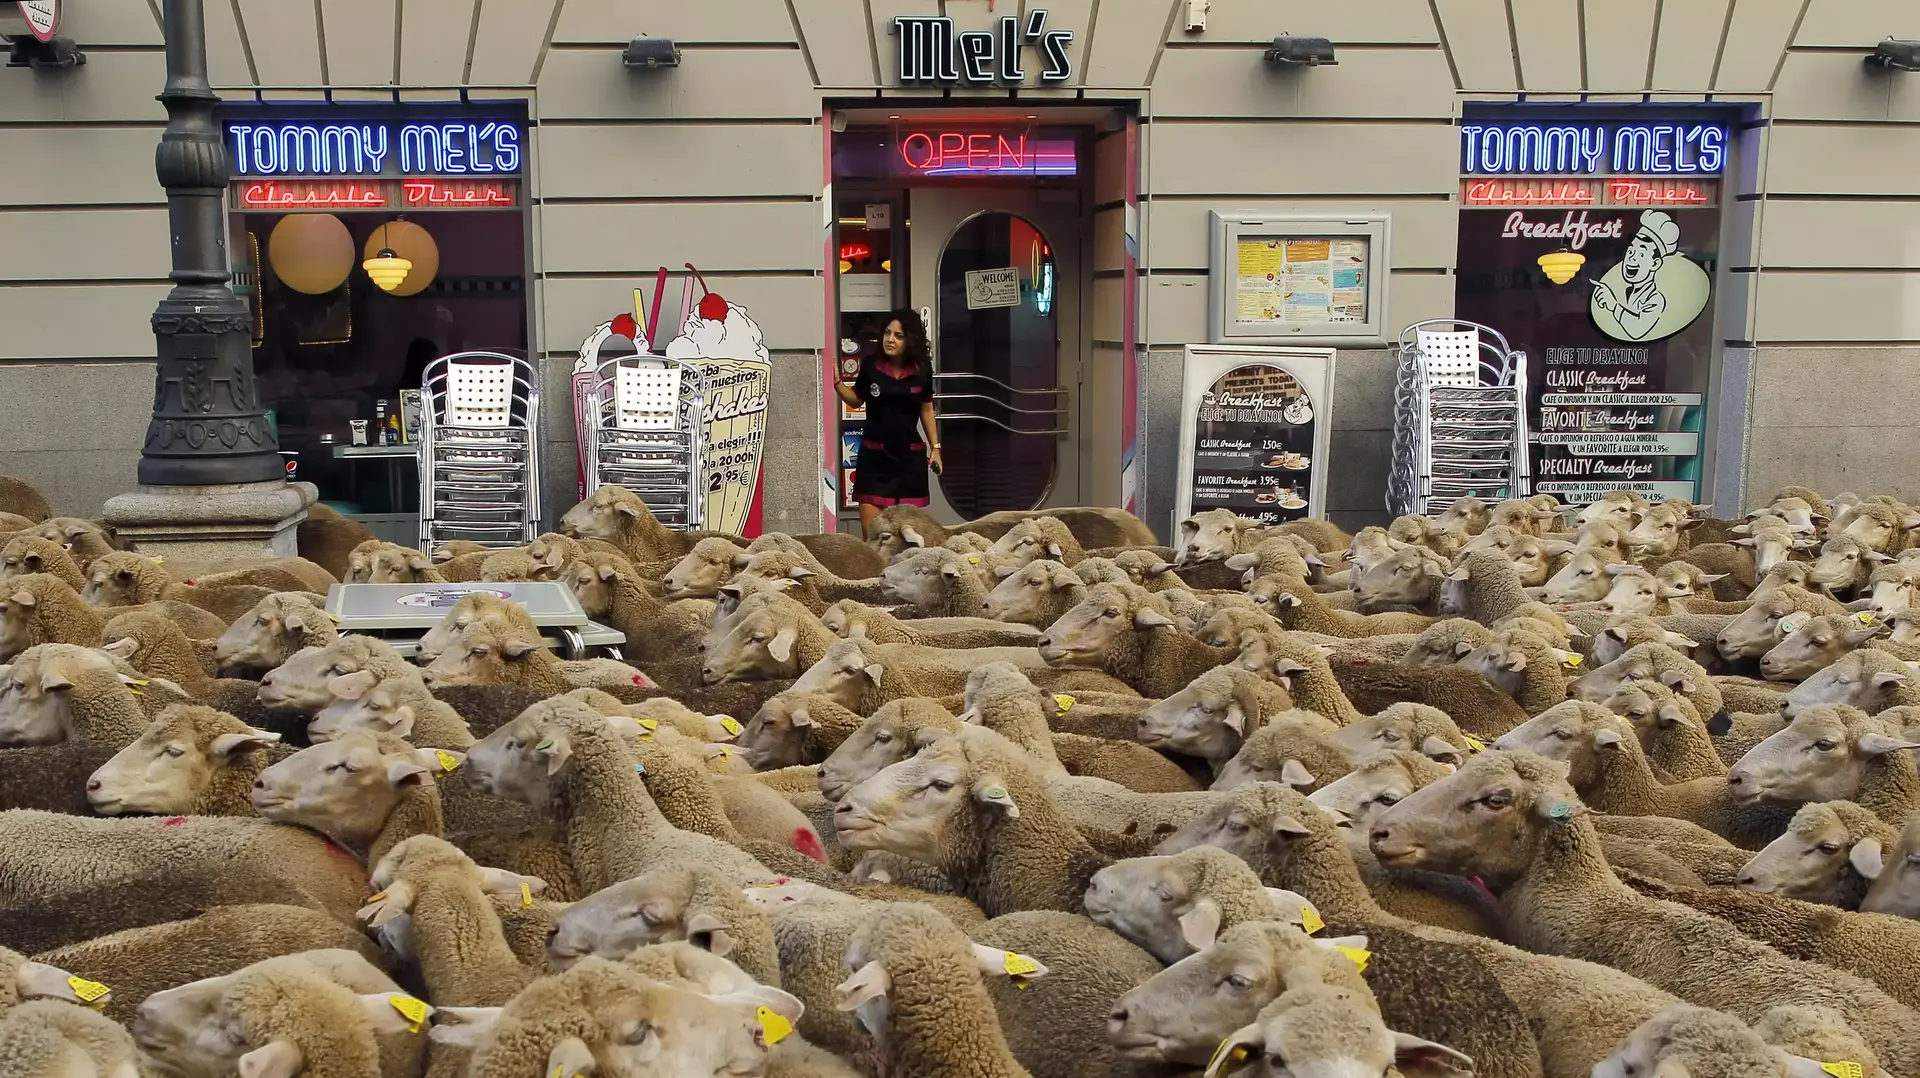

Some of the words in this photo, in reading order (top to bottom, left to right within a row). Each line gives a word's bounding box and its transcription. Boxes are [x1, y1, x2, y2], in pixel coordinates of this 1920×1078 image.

[894, 9, 1074, 82] Mel's
[229, 125, 388, 173] TOMMY
[400, 122, 519, 173] MEL'S
[903, 133, 1024, 168] OPEN
[1462, 125, 1604, 172] TOMMY
[1613, 125, 1723, 172] MEL'S
[244, 183, 386, 204] Classic
[403, 183, 512, 203] Diner
[1468, 181, 1596, 201] Classic
[1611, 182, 1708, 201] Diner
[1502, 211, 1623, 250] Breakfast
[982, 272, 1015, 284] WELCOME
[1546, 348, 1574, 364] ELIGE
[1577, 348, 1592, 364] TU
[1593, 348, 1649, 364] DESAYUNO!
[711, 371, 758, 389] nuestros
[1546, 370, 1585, 387] CLASSIC
[1586, 370, 1646, 390] Breakfast
[1219, 392, 1283, 411] Breakfast
[1558, 395, 1563, 403] O
[1587, 395, 1592, 403] Y
[1593, 395, 1601, 404] UN
[1602, 394, 1624, 404] CLASSIC
[1631, 395, 1648, 404] ELEGIR
[1649, 395, 1660, 403] POR
[1201, 408, 1224, 421] ELIGE
[1225, 409, 1237, 421] TU
[1542, 411, 1592, 428] FAVORITE
[1595, 410, 1655, 430] Breakfast
[1200, 439, 1220, 448] CLASSIC
[1220, 440, 1252, 450] Breakfast
[1554, 434, 1559, 442] O
[1584, 434, 1589, 442] O
[1590, 434, 1613, 442] REFRESCO
[1615, 434, 1619, 442] O
[1621, 434, 1635, 442] AGUA
[1637, 434, 1658, 442] MINERAL
[1586, 443, 1617, 453] FAVORITE
[1623, 445, 1640, 453] ELEGIR
[1641, 445, 1652, 453] POR
[1539, 459, 1593, 475] SPECIALTY
[1593, 460, 1653, 479] Breakfast
[1198, 475, 1225, 484] FAVORITE
[1225, 477, 1257, 488] Breakfast
[1551, 483, 1555, 491] O
[1581, 483, 1585, 491] O
[1587, 483, 1611, 491] REFRESCO
[1611, 483, 1616, 491] O
[1617, 483, 1632, 491] AGUA
[1633, 483, 1654, 491] MINERAL
[1569, 493, 1573, 501] Y
[1574, 493, 1582, 501] UN
